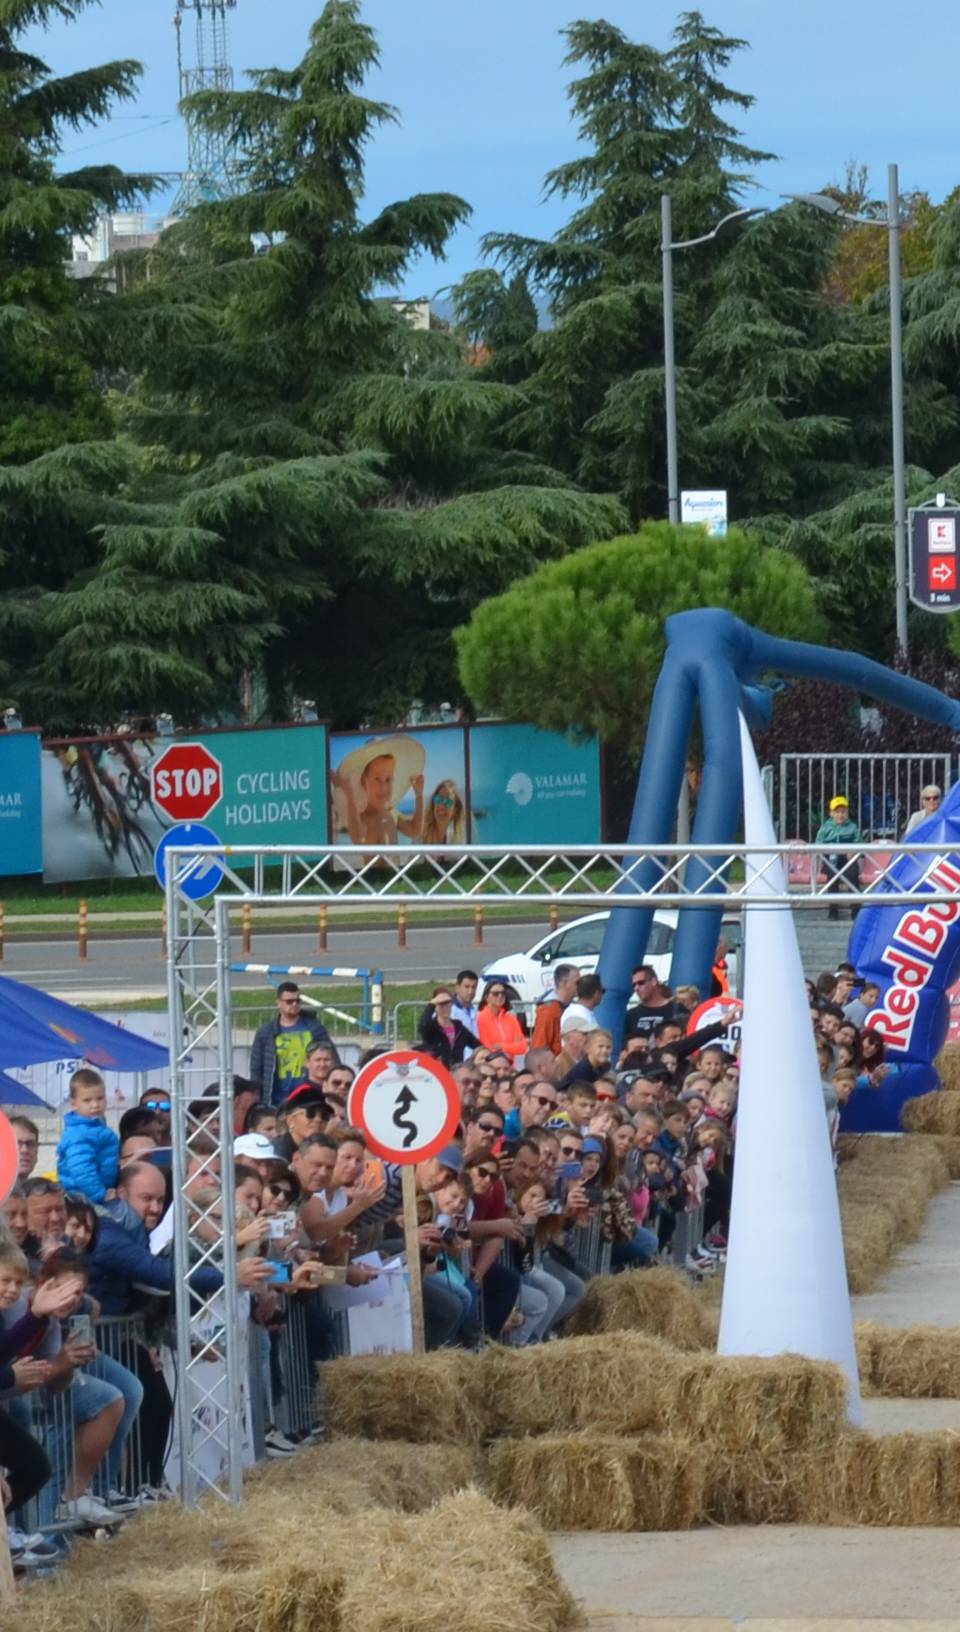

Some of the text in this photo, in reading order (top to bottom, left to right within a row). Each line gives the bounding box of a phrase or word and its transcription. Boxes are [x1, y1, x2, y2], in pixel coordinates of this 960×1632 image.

[156, 767, 218, 798] STOP
[236, 769, 311, 795] CYCLING
[535, 772, 588, 788] VALAMAR
[225, 799, 312, 826] HOLIDAYS
[864, 946, 933, 1051] Red
